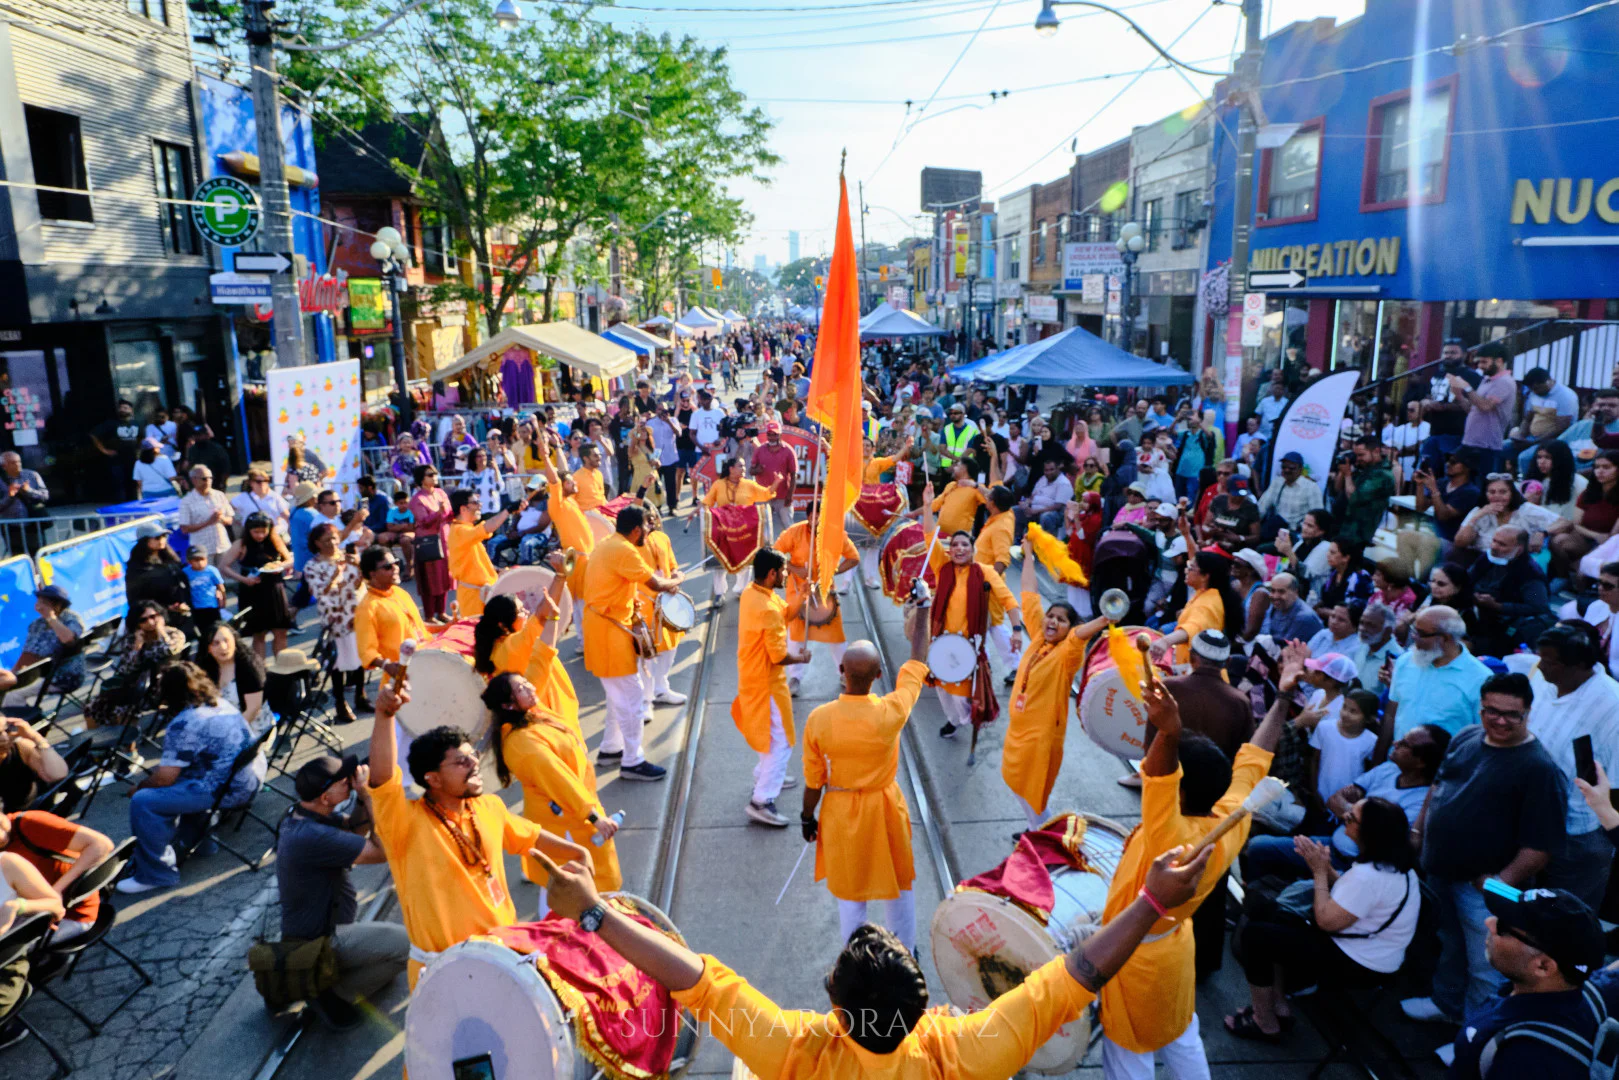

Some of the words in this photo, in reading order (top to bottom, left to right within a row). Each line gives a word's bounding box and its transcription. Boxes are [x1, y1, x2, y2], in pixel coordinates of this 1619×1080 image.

[213, 195, 239, 222] P
[197, 215, 257, 244] PARKING
[216, 285, 256, 296] Hiawatha
[794, 444, 809, 460] OF
[795, 452, 829, 486] SIA
